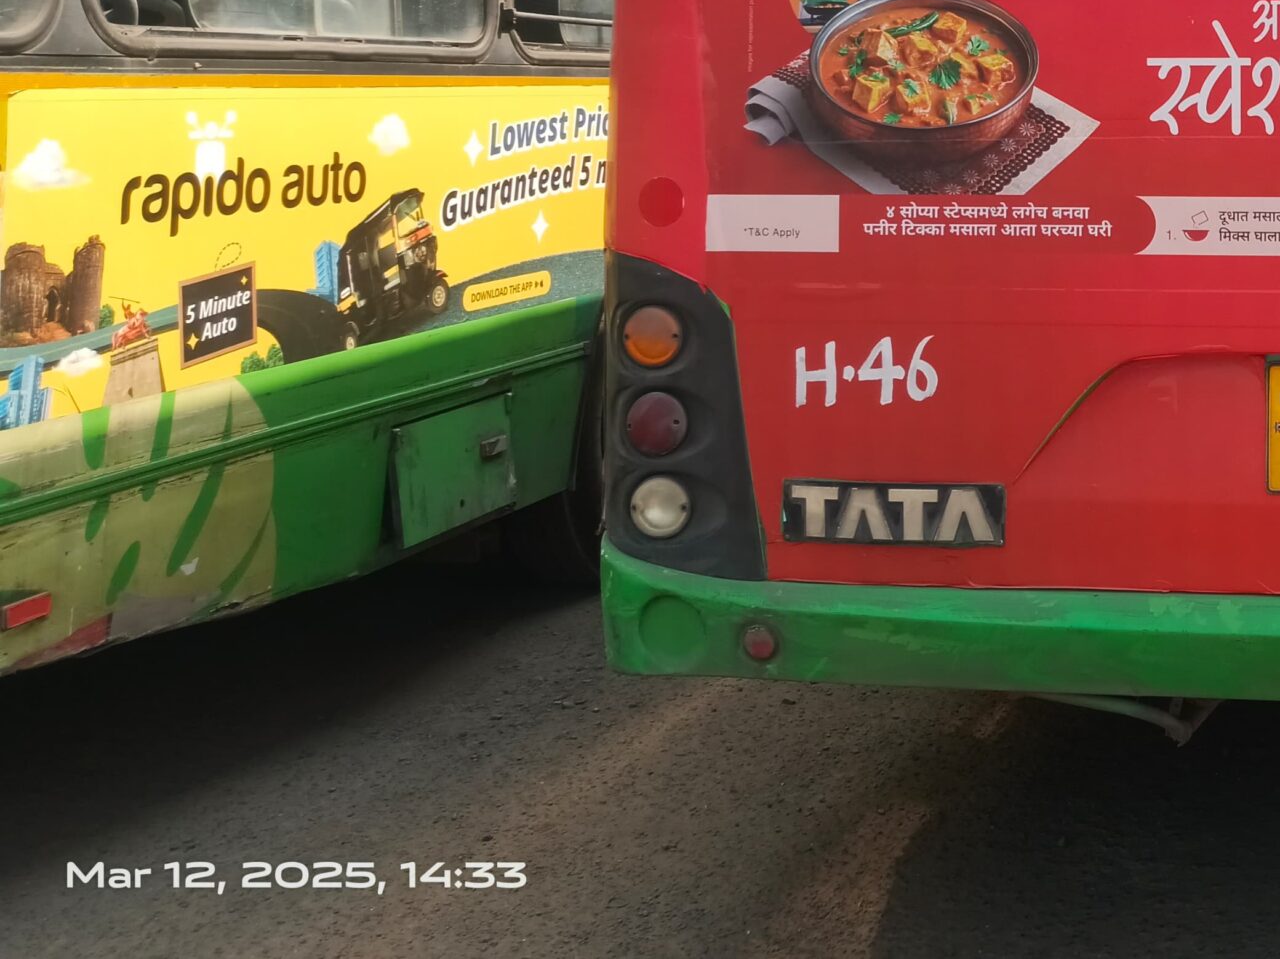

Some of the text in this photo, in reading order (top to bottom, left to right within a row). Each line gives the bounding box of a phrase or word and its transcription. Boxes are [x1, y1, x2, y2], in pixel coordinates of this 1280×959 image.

[489, 111, 568, 159] Lowest
[120, 151, 367, 238] rapido auto
[441, 155, 575, 230] Guaranteed
[579, 155, 592, 186] 5
[886, 206, 895, 220] ४
[900, 202, 939, 220] सोप्या
[1012, 202, 1047, 220] लगेच
[1052, 205, 1090, 221] बनवा
[1219, 210, 1249, 224] दूधात
[773, 227, 801, 240] Apply
[863, 219, 1113, 238] पनीर टिक्का मसाला आता घरच्या घरी
[1219, 227, 1250, 243] मिक्स
[470, 281, 533, 303] DOWNLOAD THE APP
[185, 287, 251, 324] 5 Minute
[201, 313, 238, 343] Auto
[791, 485, 995, 542] TATA
